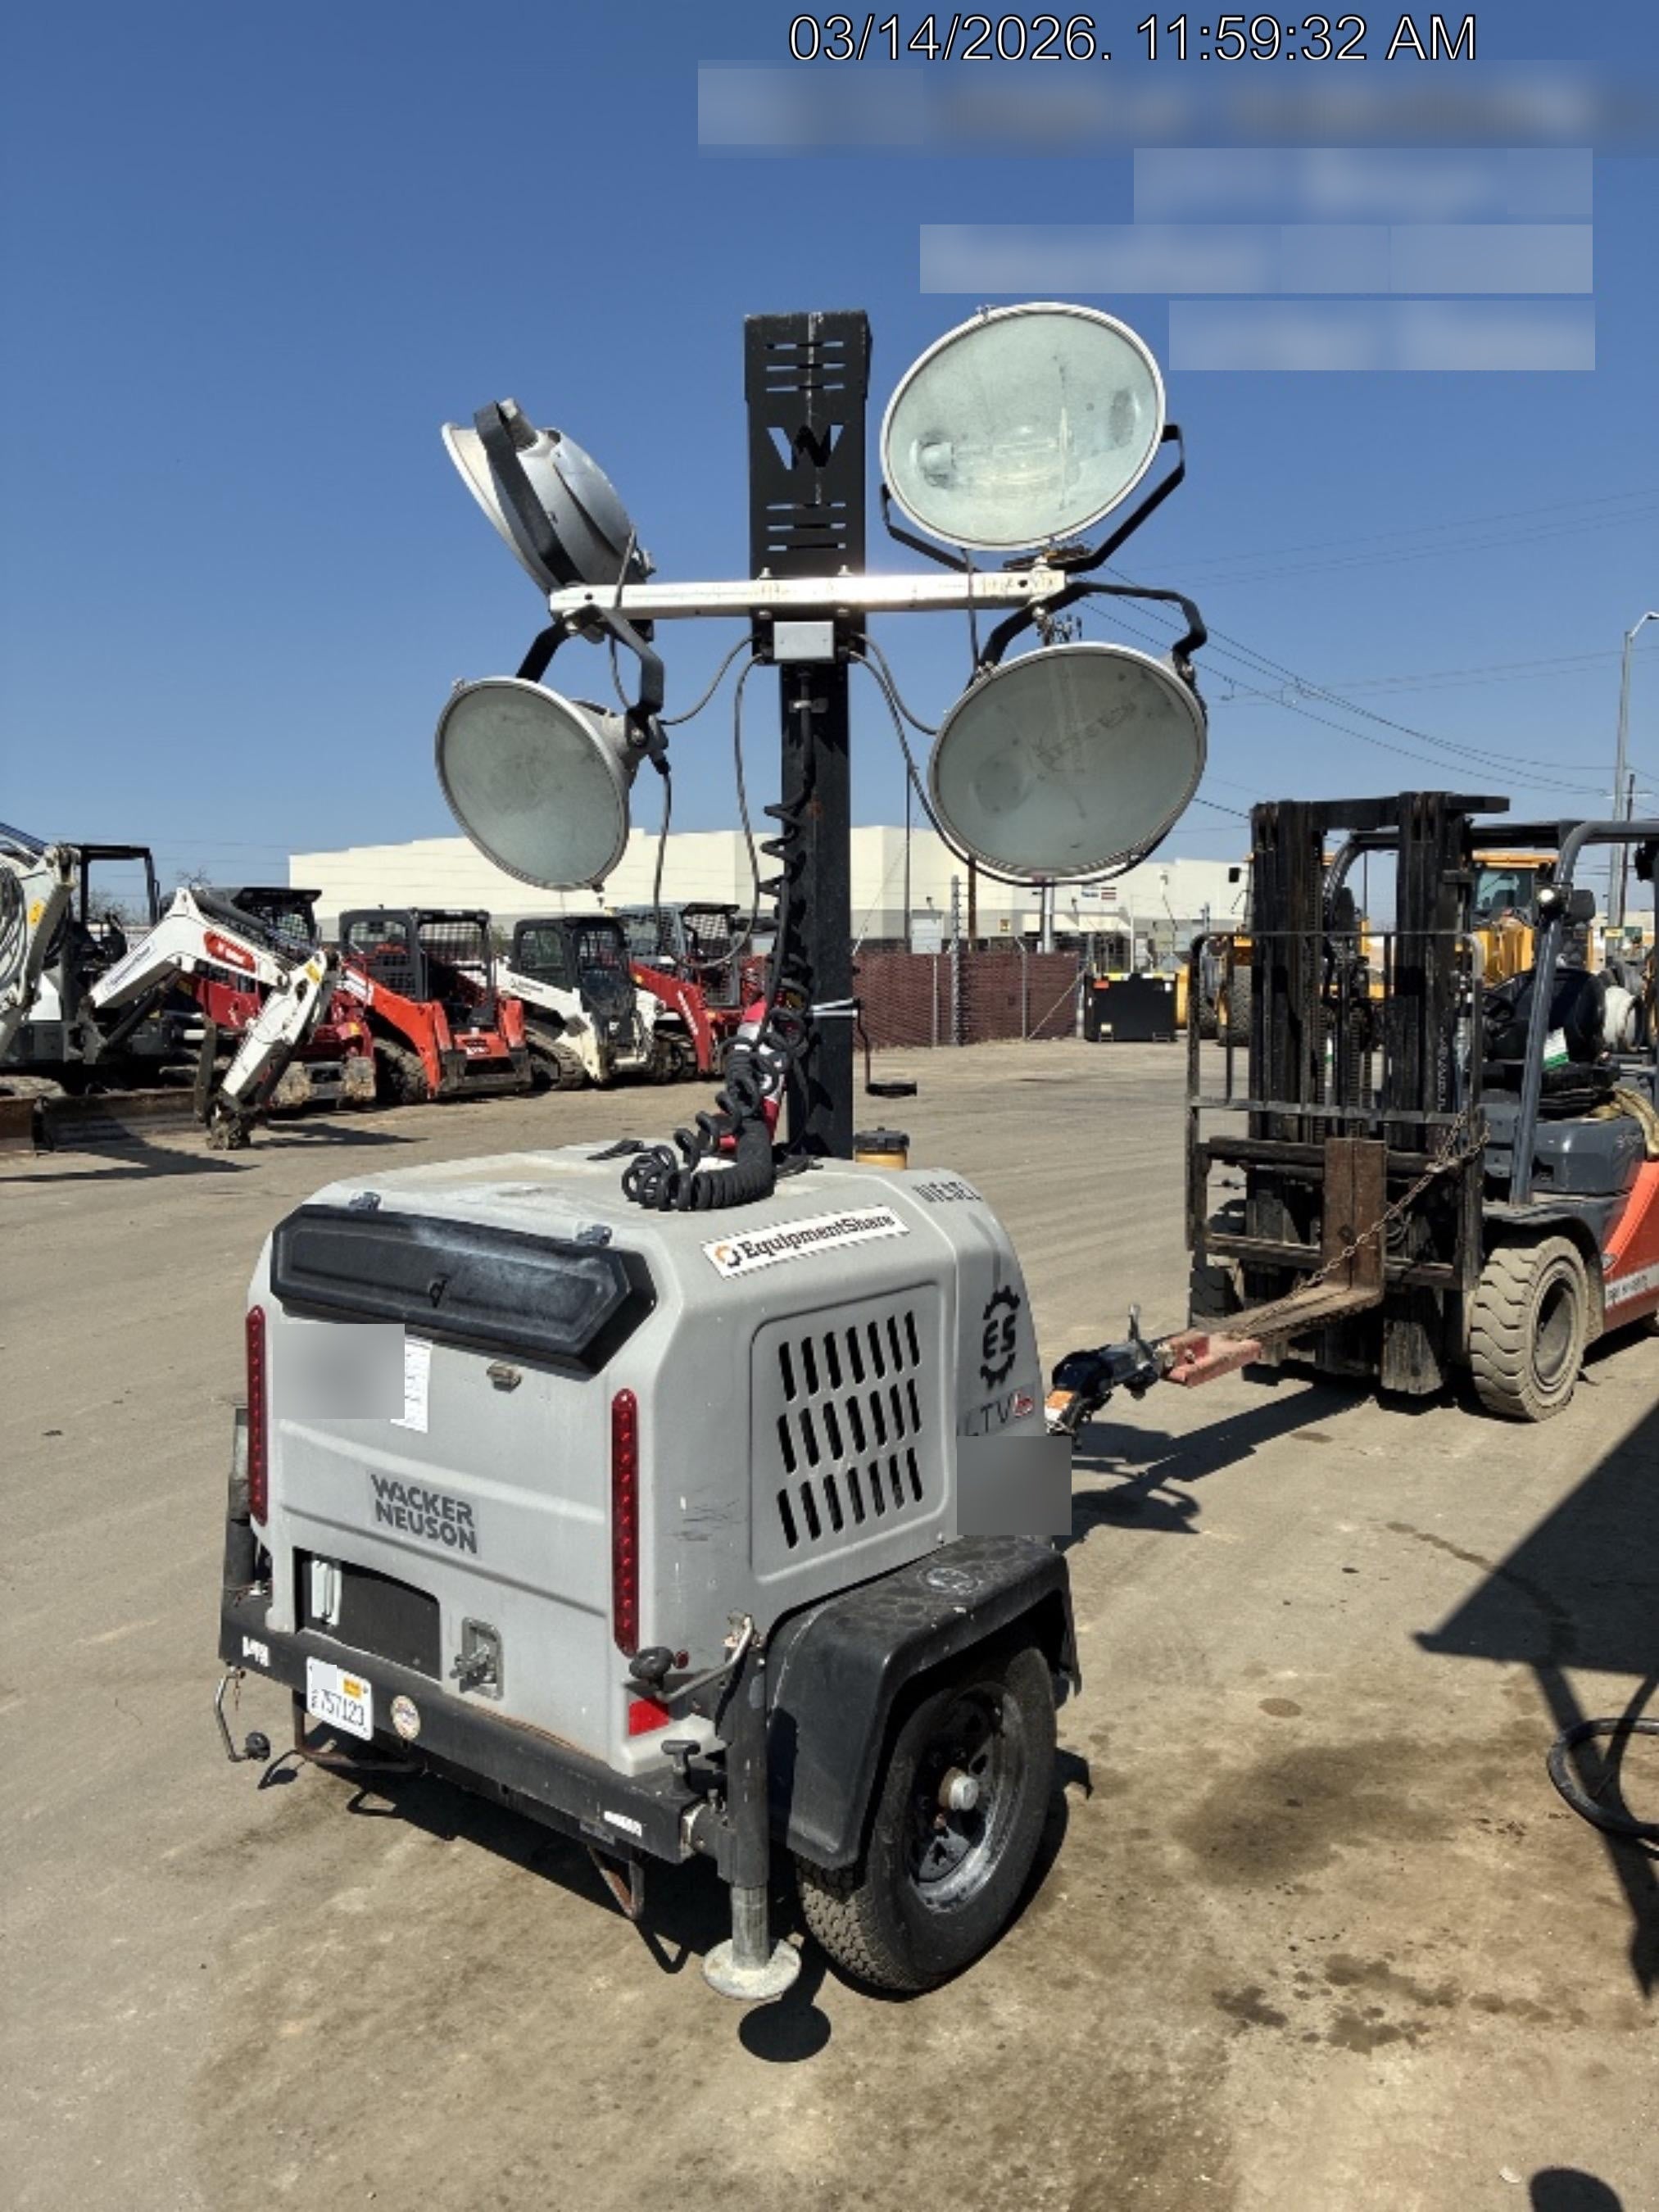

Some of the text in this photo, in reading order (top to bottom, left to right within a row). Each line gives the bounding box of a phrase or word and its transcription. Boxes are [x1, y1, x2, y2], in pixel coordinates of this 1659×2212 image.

[738, 1213, 896, 1259] EquipmentShare
[983, 1313, 1017, 1361] ES
[370, 1474, 475, 1529] WACKER
[375, 1498, 478, 1554] NEUSON
